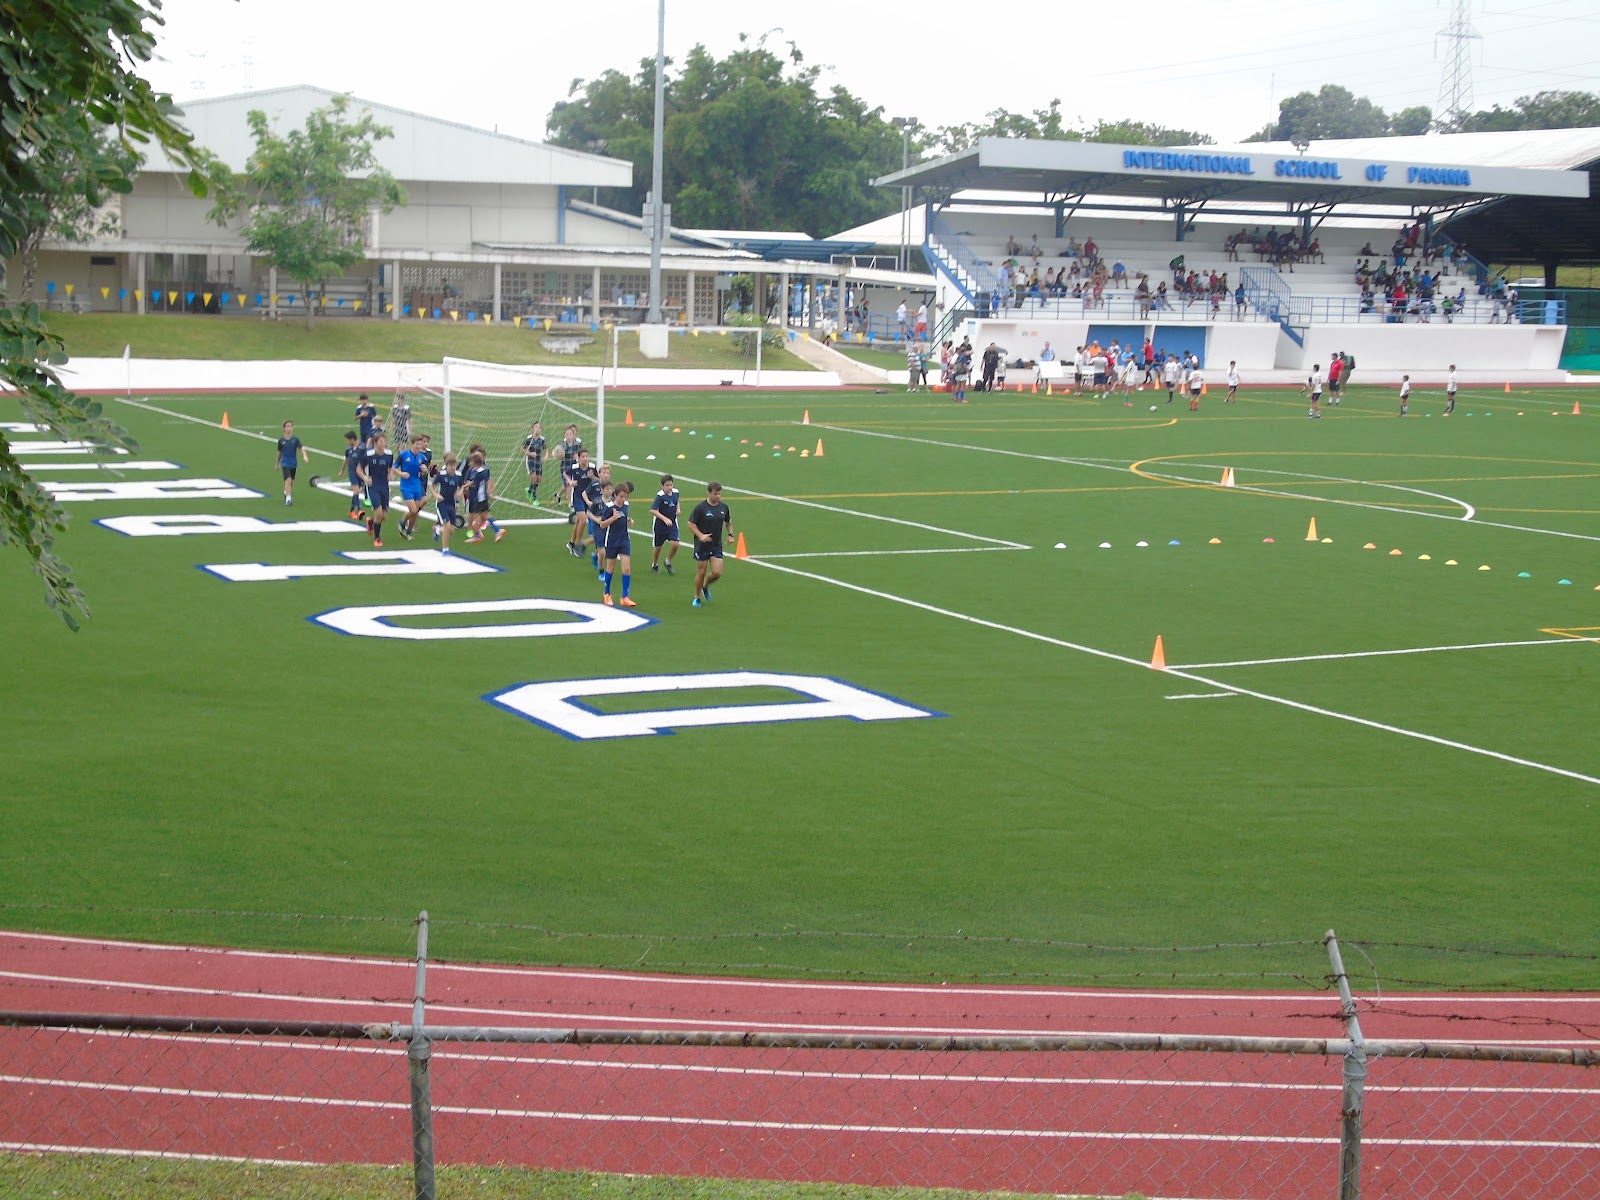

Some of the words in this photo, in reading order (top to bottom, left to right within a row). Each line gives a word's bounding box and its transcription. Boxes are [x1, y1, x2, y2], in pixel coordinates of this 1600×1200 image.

[1123, 150, 1254, 175] INTERNATIONAL
[1275, 159, 1342, 179] SCHOOL
[1366, 164, 1388, 181] OF
[1408, 166, 1471, 186] PANAMA
